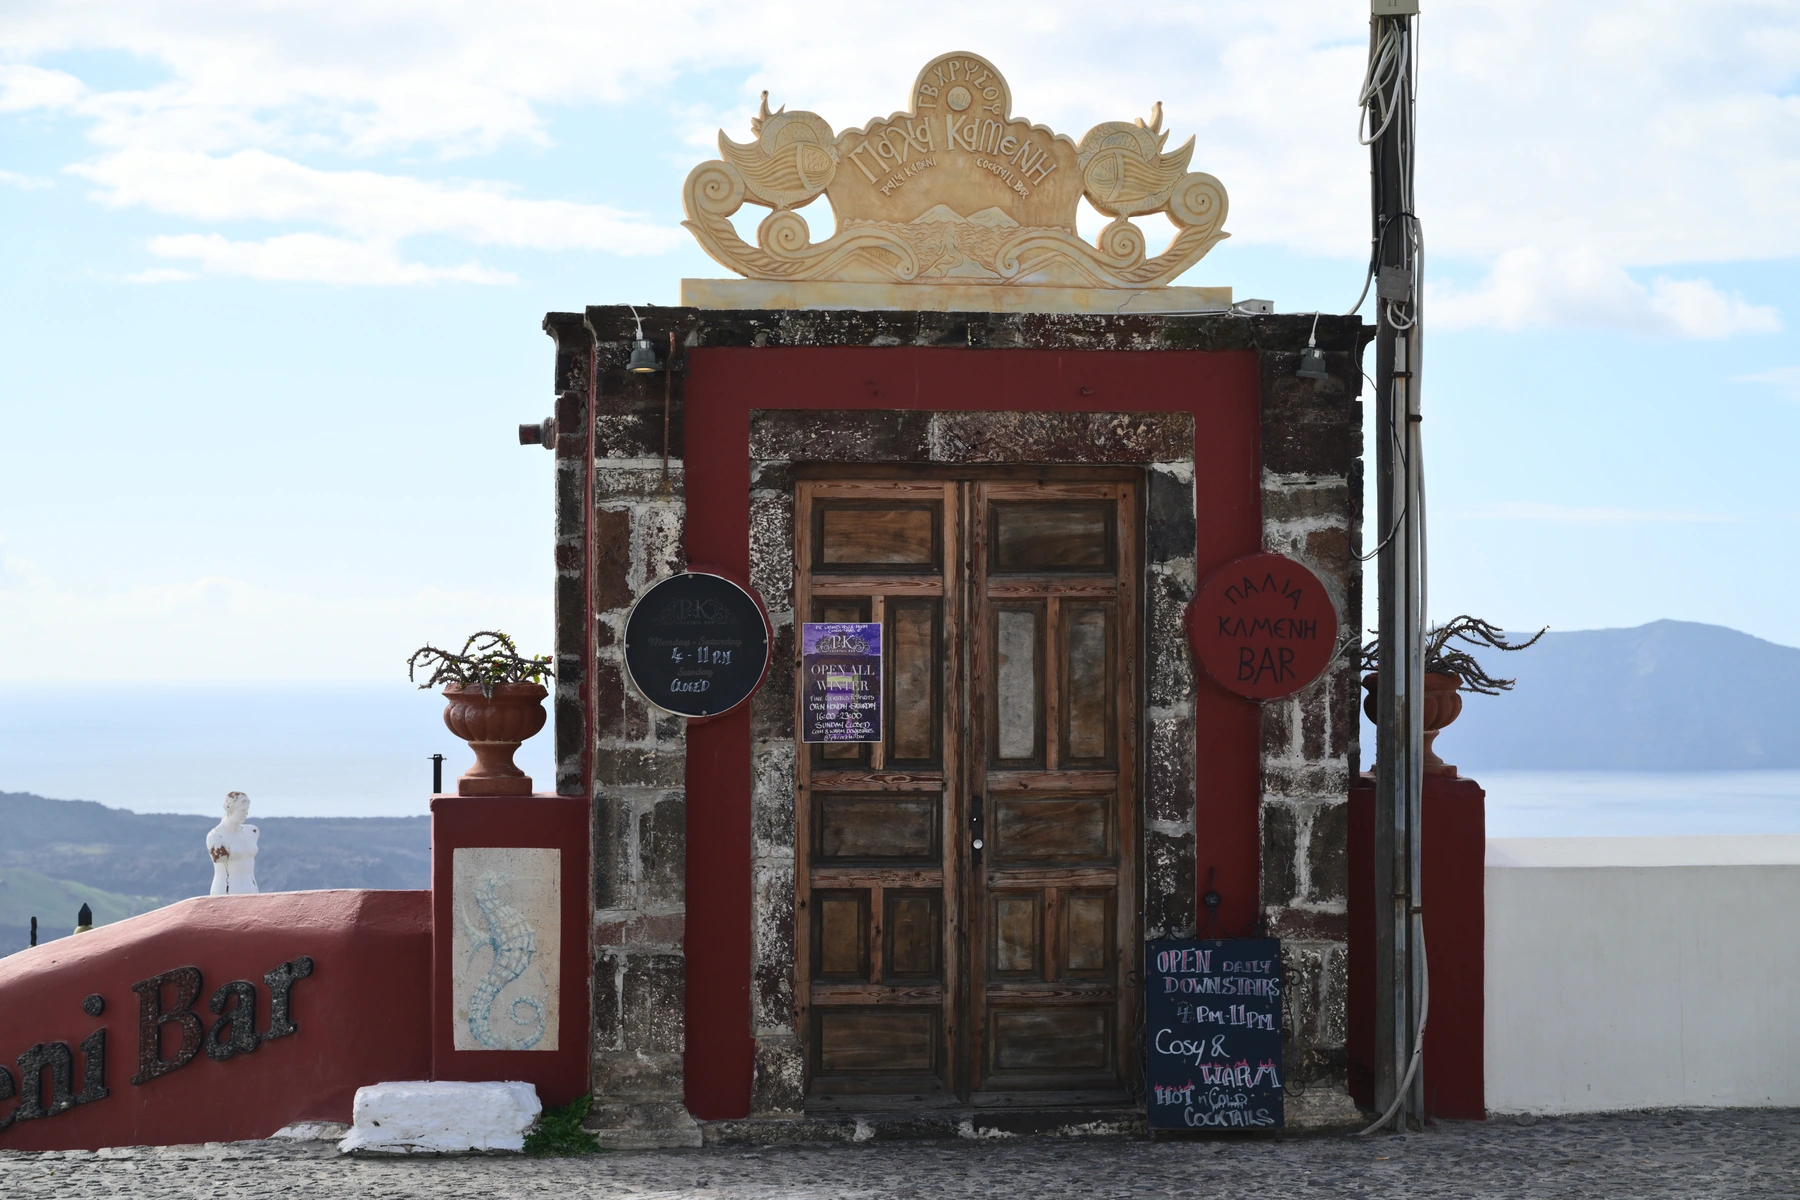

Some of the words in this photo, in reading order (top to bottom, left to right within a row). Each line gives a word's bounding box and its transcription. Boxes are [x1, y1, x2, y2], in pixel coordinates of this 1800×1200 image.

[648, 637, 691, 648] Monday
[698, 636, 742, 647] Saturday
[671, 646, 683, 664] 4
[677, 667, 714, 677] Sunday
[811, 664, 845, 675] OPEN
[850, 664, 875, 676] ALL
[1237, 646, 1295, 685] BAR
[670, 678, 710, 692] CLOSED
[816, 680, 869, 691] WINTER
[809, 702, 826, 711] OPEN
[827, 702, 848, 710] MONDAY
[816, 712, 836, 720] 16:00
[840, 712, 862, 720] 23:00
[815, 721, 844, 729] SUNDAY
[845, 721, 871, 729] CLOSED
[1157, 948, 1213, 974] OPEN
[1222, 960, 1273, 974] DAILY
[1163, 975, 1280, 1003] DOWNSTAIRS
[130, 956, 315, 1086] Bar
[1155, 1028, 1206, 1066] Cosy
[1210, 1034, 1231, 1058] &
[1200, 1063, 1282, 1088] WARM
[1184, 1106, 1276, 1127] COCKTAILS
